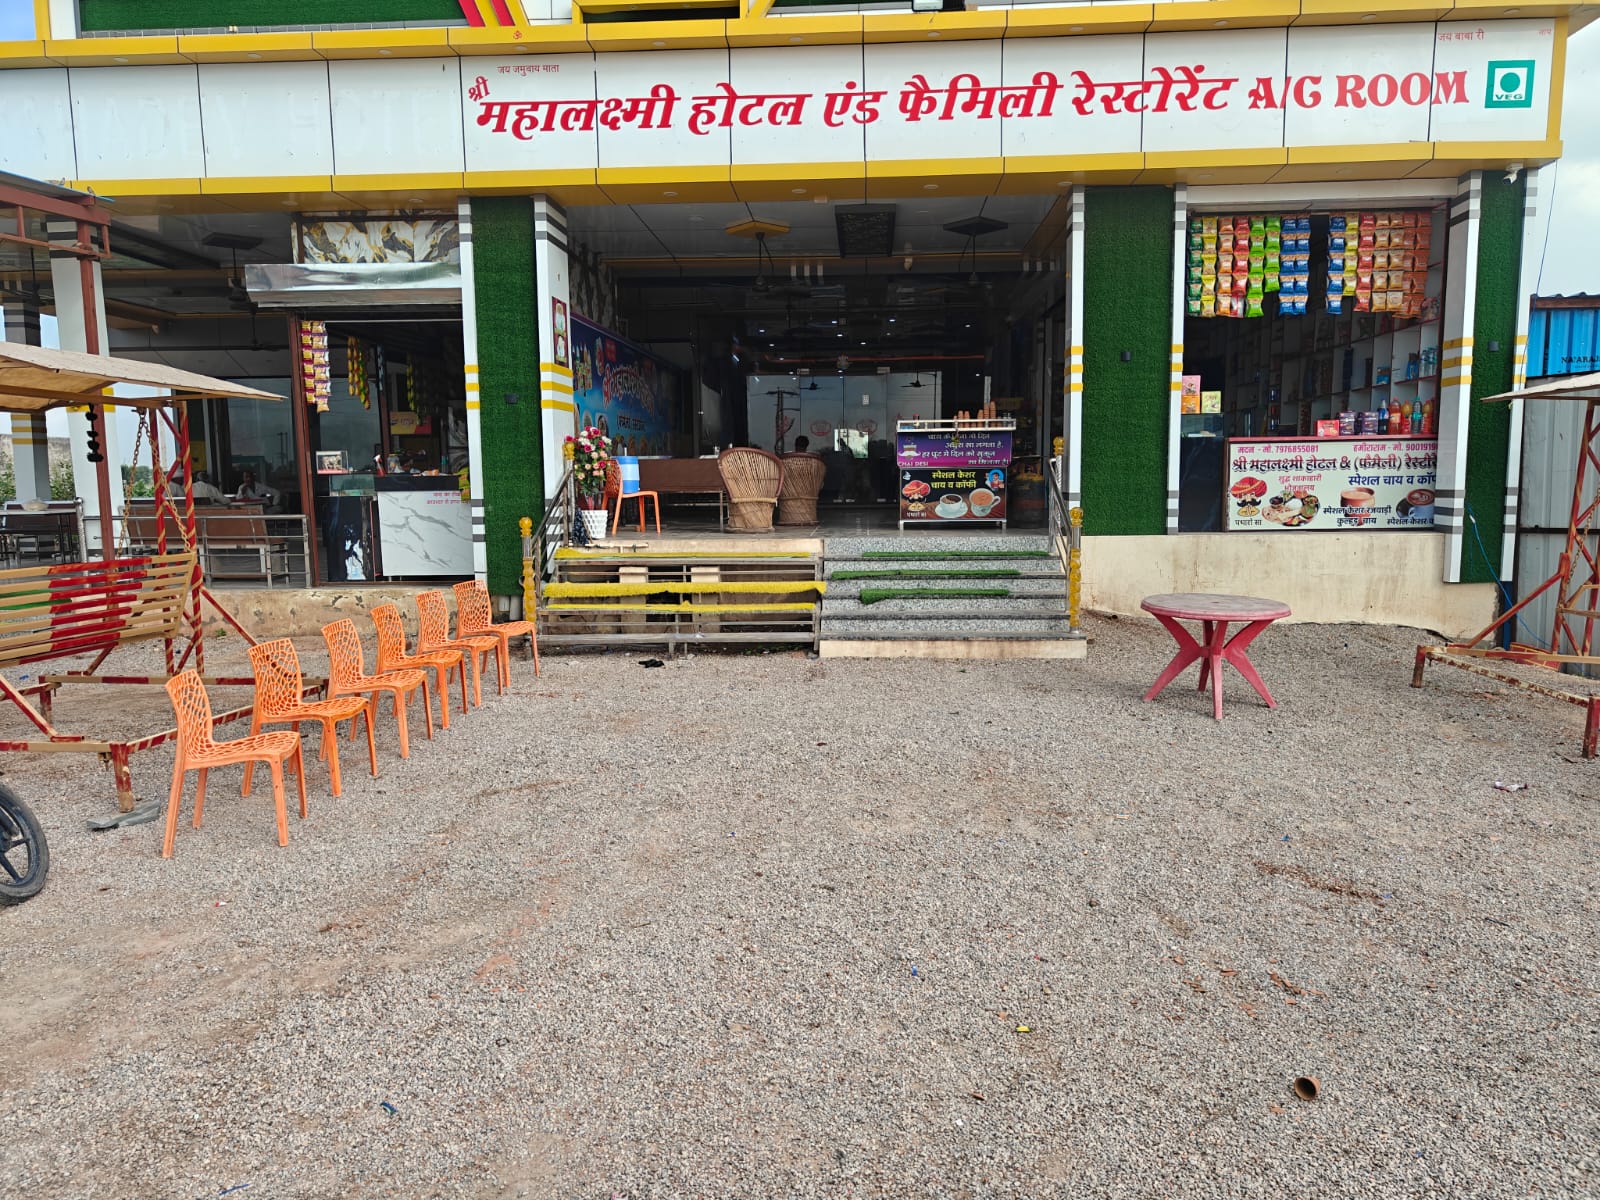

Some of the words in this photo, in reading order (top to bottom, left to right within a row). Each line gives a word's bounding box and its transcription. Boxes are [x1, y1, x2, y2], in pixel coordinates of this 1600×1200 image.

[496, 65, 511, 74] जय
[468, 76, 491, 102] श्री
[898, 72, 1064, 122] फैमिली
[1071, 64, 1239, 116] रेस्टोरेंट
[1334, 71, 1469, 109] ROOM
[476, 83, 681, 140] महालक्ष्मी
[688, 82, 812, 136] होटल
[823, 81, 886, 128] एंड
[931, 470, 955, 479] स्पेशल
[1232, 456, 1249, 471] श्री
[1249, 455, 1304, 473] महालक्ष्मी
[1305, 454, 1337, 473] होटल
[1339, 456, 1351, 469] &
[930, 481, 946, 489] चाय
[947, 481, 954, 489] व
[955, 480, 977, 489] कॉफी
[1348, 472, 1380, 486] स्पेशल
[1383, 475, 1403, 485] चाय
[1406, 475, 1415, 485] व
[1323, 505, 1346, 514] स्पेशल
